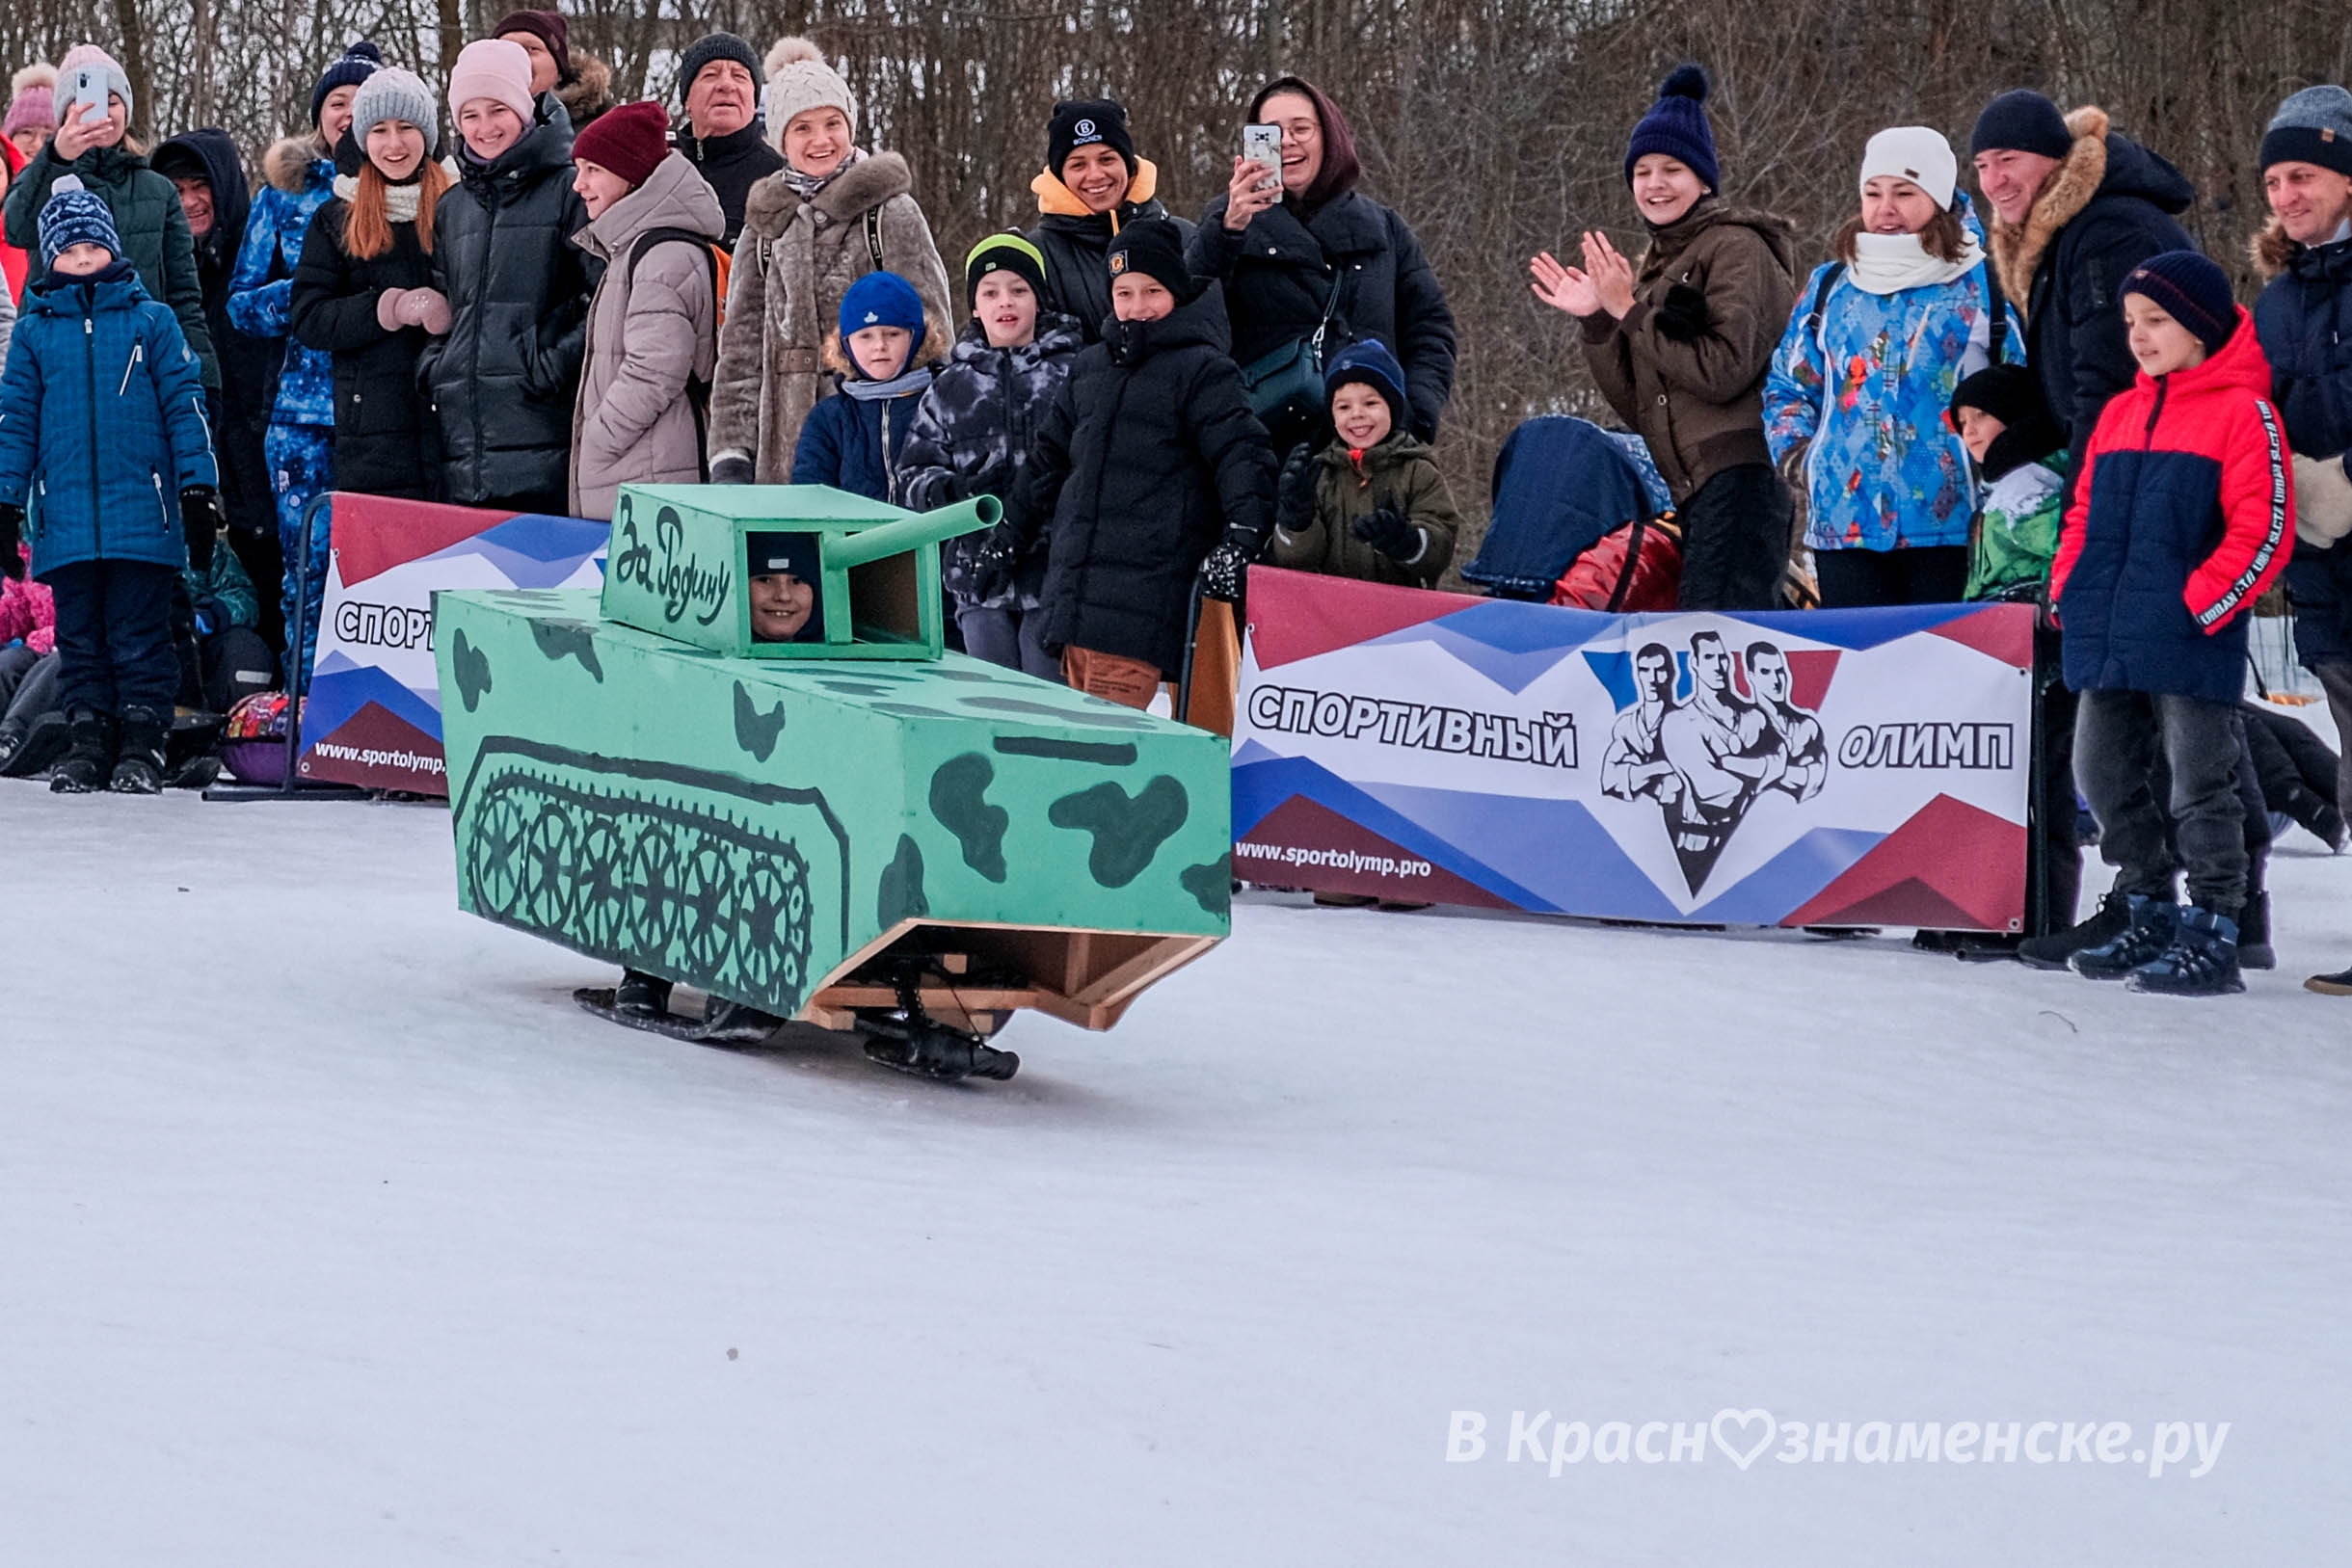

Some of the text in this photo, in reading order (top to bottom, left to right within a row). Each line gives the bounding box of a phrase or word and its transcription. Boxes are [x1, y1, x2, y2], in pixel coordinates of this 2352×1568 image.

[616, 493, 731, 626] За Родину
[1248, 684, 2013, 769] СПОРТИВНЫЙ ОЛИМП
[315, 741, 447, 775] www.sportolymp.
[1235, 840, 1431, 878] www.sportolymp.pro
